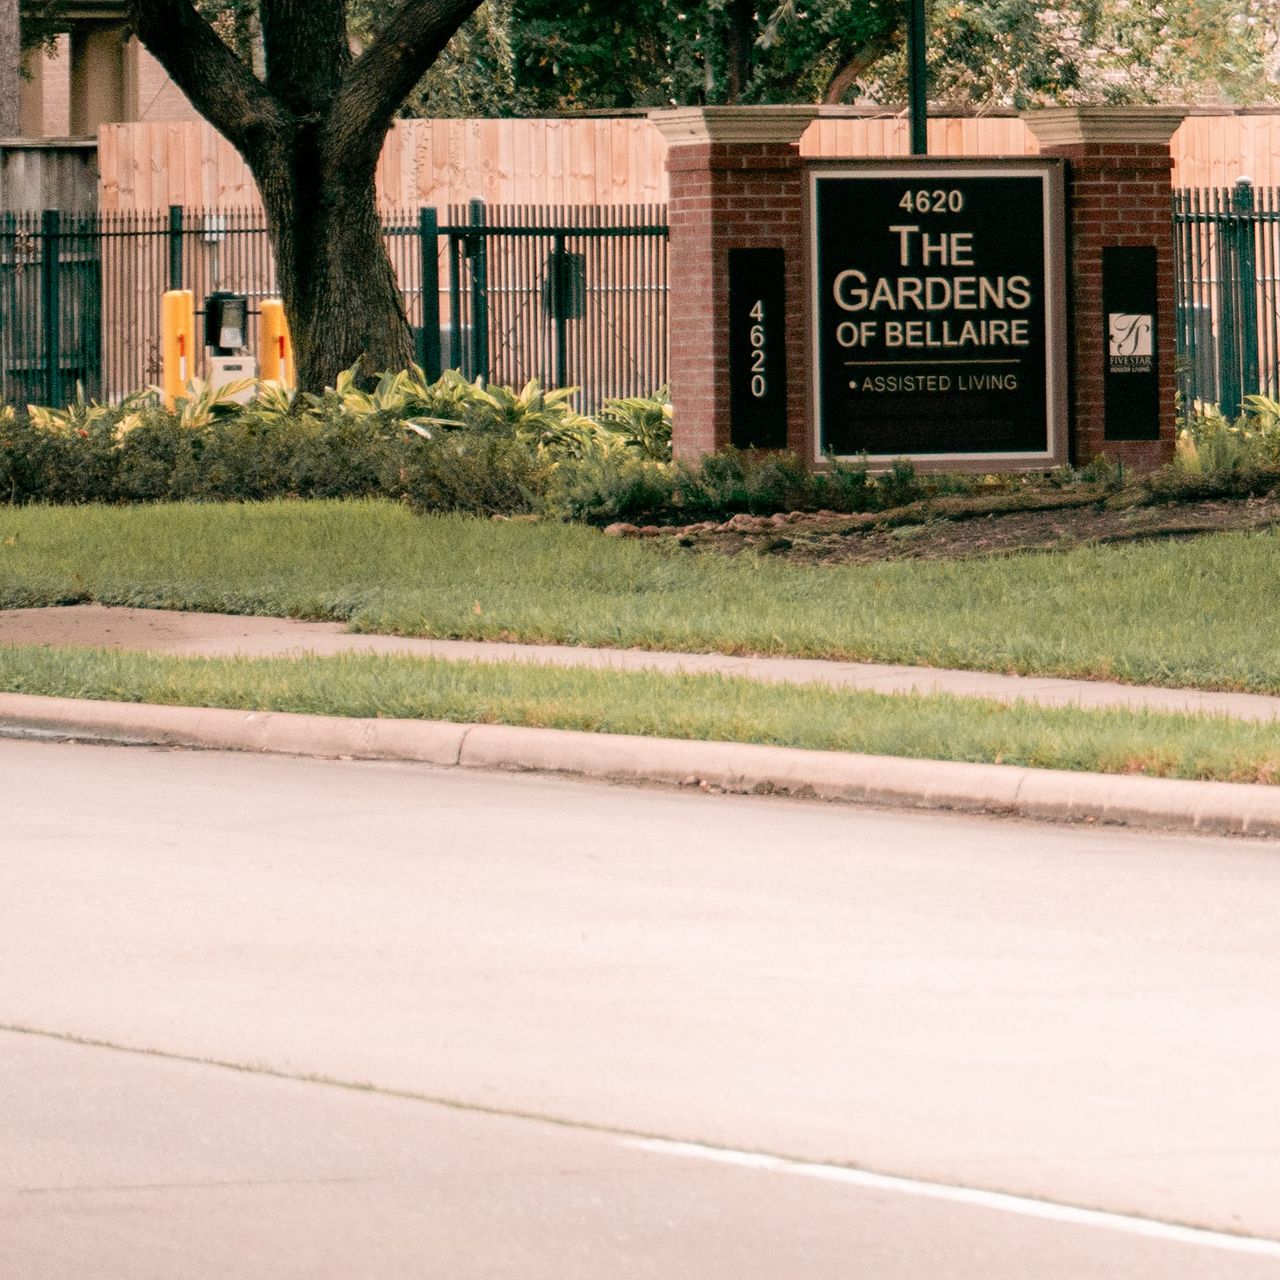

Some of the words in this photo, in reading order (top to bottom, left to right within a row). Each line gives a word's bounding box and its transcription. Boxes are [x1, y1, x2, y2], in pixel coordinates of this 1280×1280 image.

[898, 189, 964, 213] 4620
[888, 224, 975, 267] THE
[832, 269, 1032, 312] GARDENS
[836, 321, 878, 348] OF
[884, 319, 1030, 348] BELLAIRE
[749, 299, 766, 398] 4620
[1110, 356, 1129, 365] FIVE
[1129, 356, 1151, 365] STAR
[861, 375, 950, 392] ASSISTED
[958, 374, 1017, 391] LIVING
